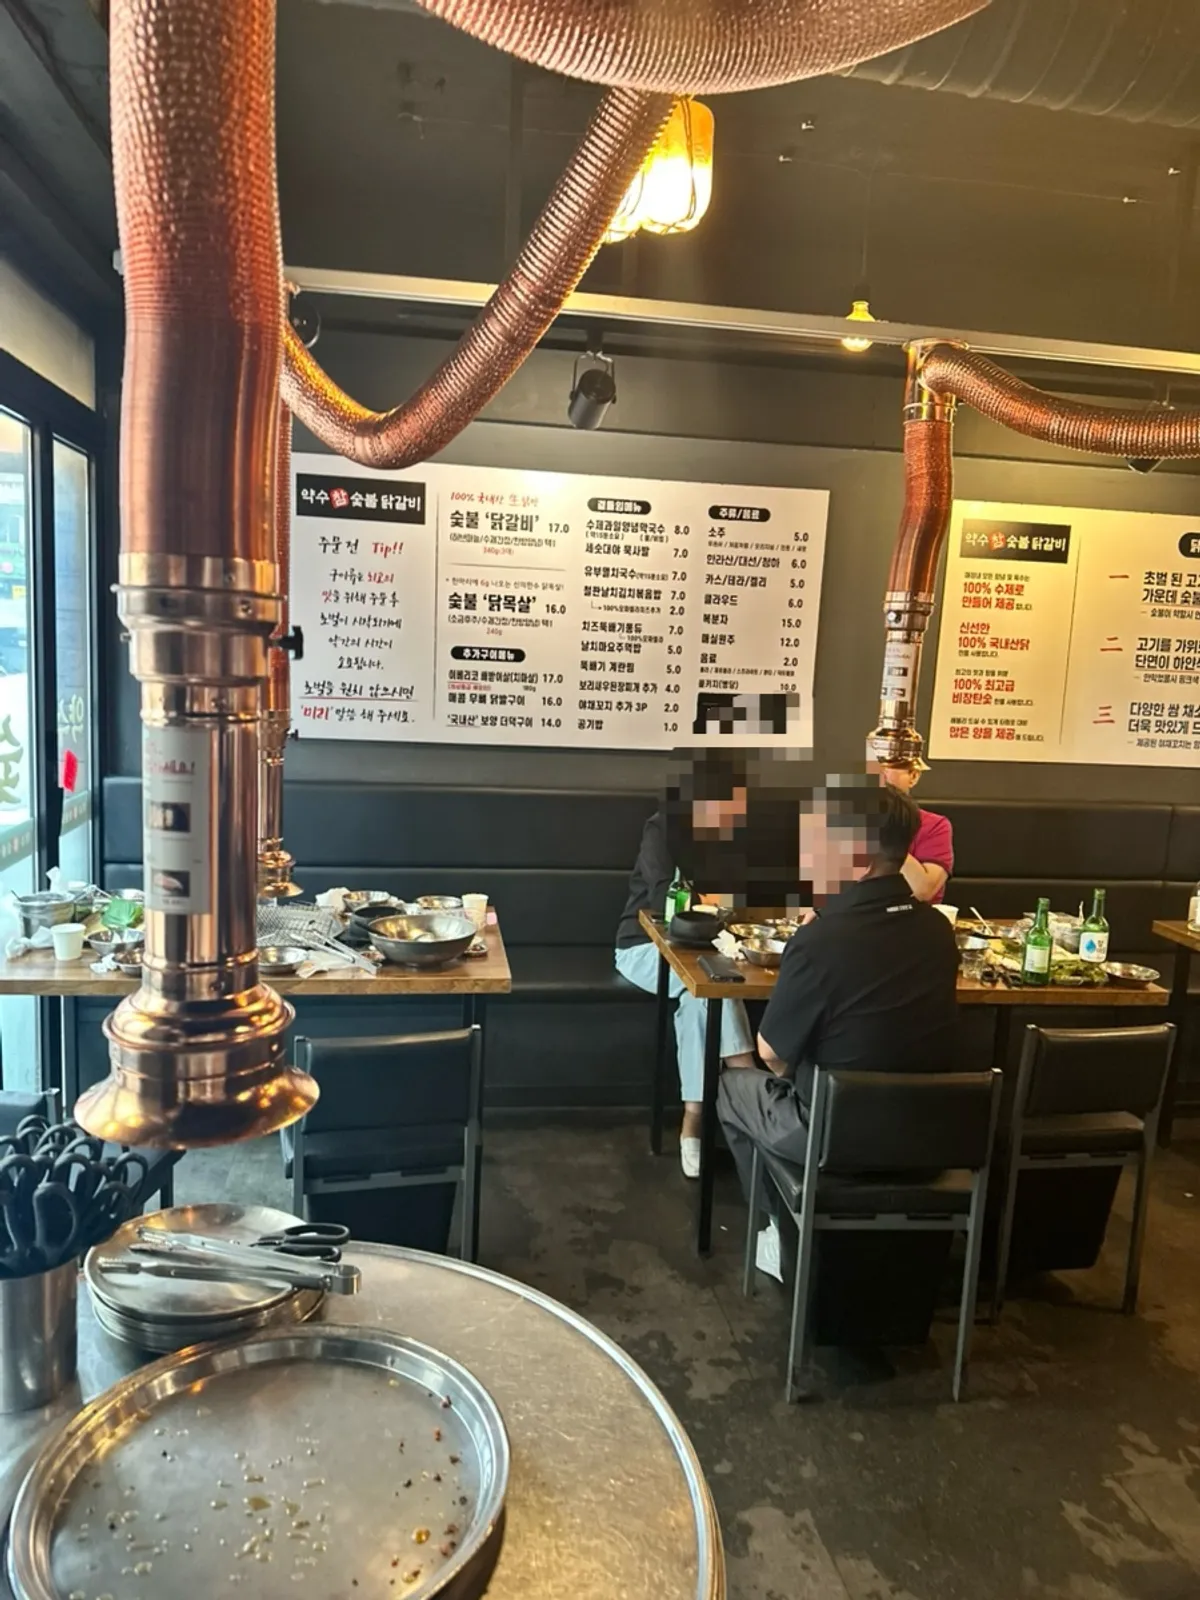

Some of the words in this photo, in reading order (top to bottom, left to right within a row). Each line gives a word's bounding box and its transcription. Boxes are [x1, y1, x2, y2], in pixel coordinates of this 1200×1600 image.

[301, 488, 330, 505] 약수
[381, 494, 421, 512] 닭갈비
[450, 492, 475, 502] 100%
[478, 492, 505, 505] 국내산
[450, 510, 479, 529] 숯불
[548, 522, 570, 534] 17.0
[674, 525, 690, 535] 8.0
[708, 526, 726, 538] 소주
[794, 532, 809, 542] 5.0
[318, 535, 342, 554] 주문
[346, 538, 359, 554] 전
[372, 542, 404, 558] Tip!!
[965, 532, 989, 547] 약수
[1031, 537, 1066, 552] 닭갈비
[673, 548, 689, 559] 7.0
[791, 559, 807, 569] 6.0
[671, 571, 687, 581] 7.0
[1143, 570, 1168, 586] 초벌
[1171, 572, 1183, 587] 된
[1185, 574, 1200, 588] 고
[789, 579, 805, 589] 5.0
[963, 582, 992, 595] 100%
[995, 584, 1024, 596] 수제로
[344, 591, 366, 604] 위해
[670, 590, 686, 601] 7.0
[704, 594, 738, 606] 클라우드
[788, 598, 803, 608] 6.0
[961, 596, 992, 609] 만들어
[1142, 588, 1178, 604] 가운데
[448, 592, 477, 610] 숯불
[545, 604, 566, 615] 16.0
[669, 605, 685, 616] 2.0
[703, 613, 728, 625] 복분자
[781, 618, 801, 628] 15.0
[668, 625, 684, 635] 7.0
[959, 622, 990, 635] 신선한
[328, 634, 361, 648] 약간의
[365, 638, 393, 650] 시간이
[701, 633, 735, 645] 매실원주
[780, 638, 800, 647] 12.0
[958, 636, 986, 649] 100%
[989, 637, 1030, 651] 국내산닭
[1136, 637, 1172, 653] 고기를
[1174, 639, 1200, 654] 가위
[463, 648, 515, 660] 추가구이메뉴
[581, 640, 642, 654] 날치마요주먹밥
[667, 645, 682, 655] 5.0
[580, 660, 606, 672] 뚝배기
[666, 664, 681, 674] 5.0
[700, 653, 717, 664] 음료
[783, 657, 798, 667] 2.0
[1135, 655, 1170, 670] 단면이
[543, 674, 563, 684] 17.0
[954, 678, 982, 690] 100%
[985, 680, 1015, 692] 최고급
[304, 680, 334, 696] 초벌을
[340, 682, 363, 697] 원치
[369, 684, 414, 699] 않으시면
[642, 682, 658, 694] 추가
[665, 684, 680, 694] 4.0
[779, 683, 797, 691] 10.0
[490, 694, 525, 706] 닭발구이
[542, 697, 562, 707] 16.0
[952, 692, 992, 705] 비장탄숯
[615, 701, 633, 712] 추가
[635, 702, 648, 711] 3P
[663, 703, 679, 713] 2.0
[1130, 702, 1165, 717] 다양한
[1167, 703, 1180, 718] 쌈
[500, 716, 533, 728] 더덕구이
[541, 718, 562, 728] 14.0
[577, 719, 604, 730] 공기밥
[663, 722, 678, 732] 1.0
[1128, 719, 1152, 733] 더욱
[1154, 719, 1190, 735] 맛있게
[949, 726, 969, 739] 많은
